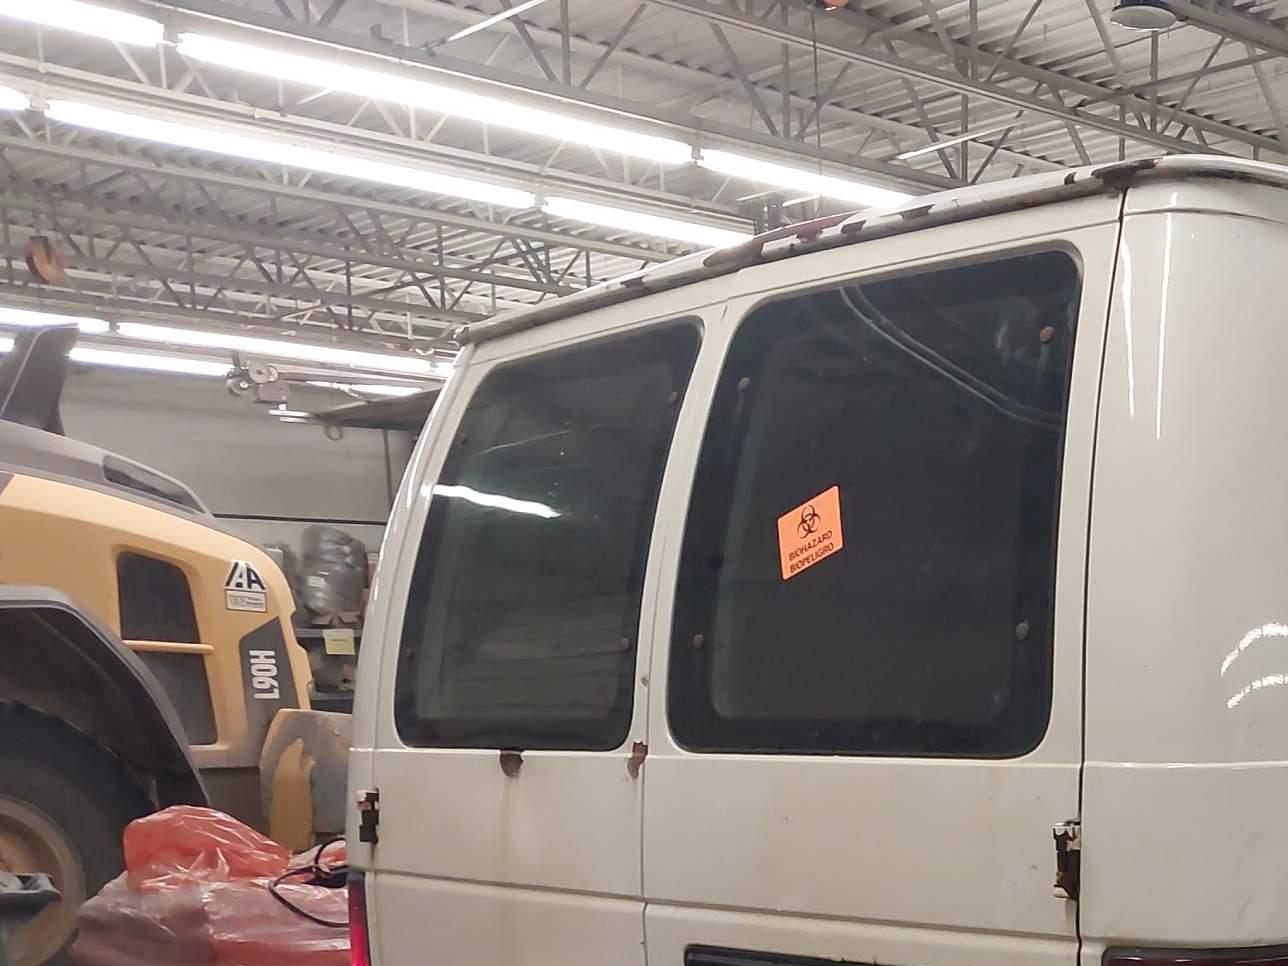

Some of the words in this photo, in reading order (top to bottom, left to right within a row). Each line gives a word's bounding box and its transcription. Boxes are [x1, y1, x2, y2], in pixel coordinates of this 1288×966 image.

[788, 530, 833, 561] BIOHAZARD
[789, 542, 834, 574] BIOPELIGRO
[249, 650, 280, 699] L90H
